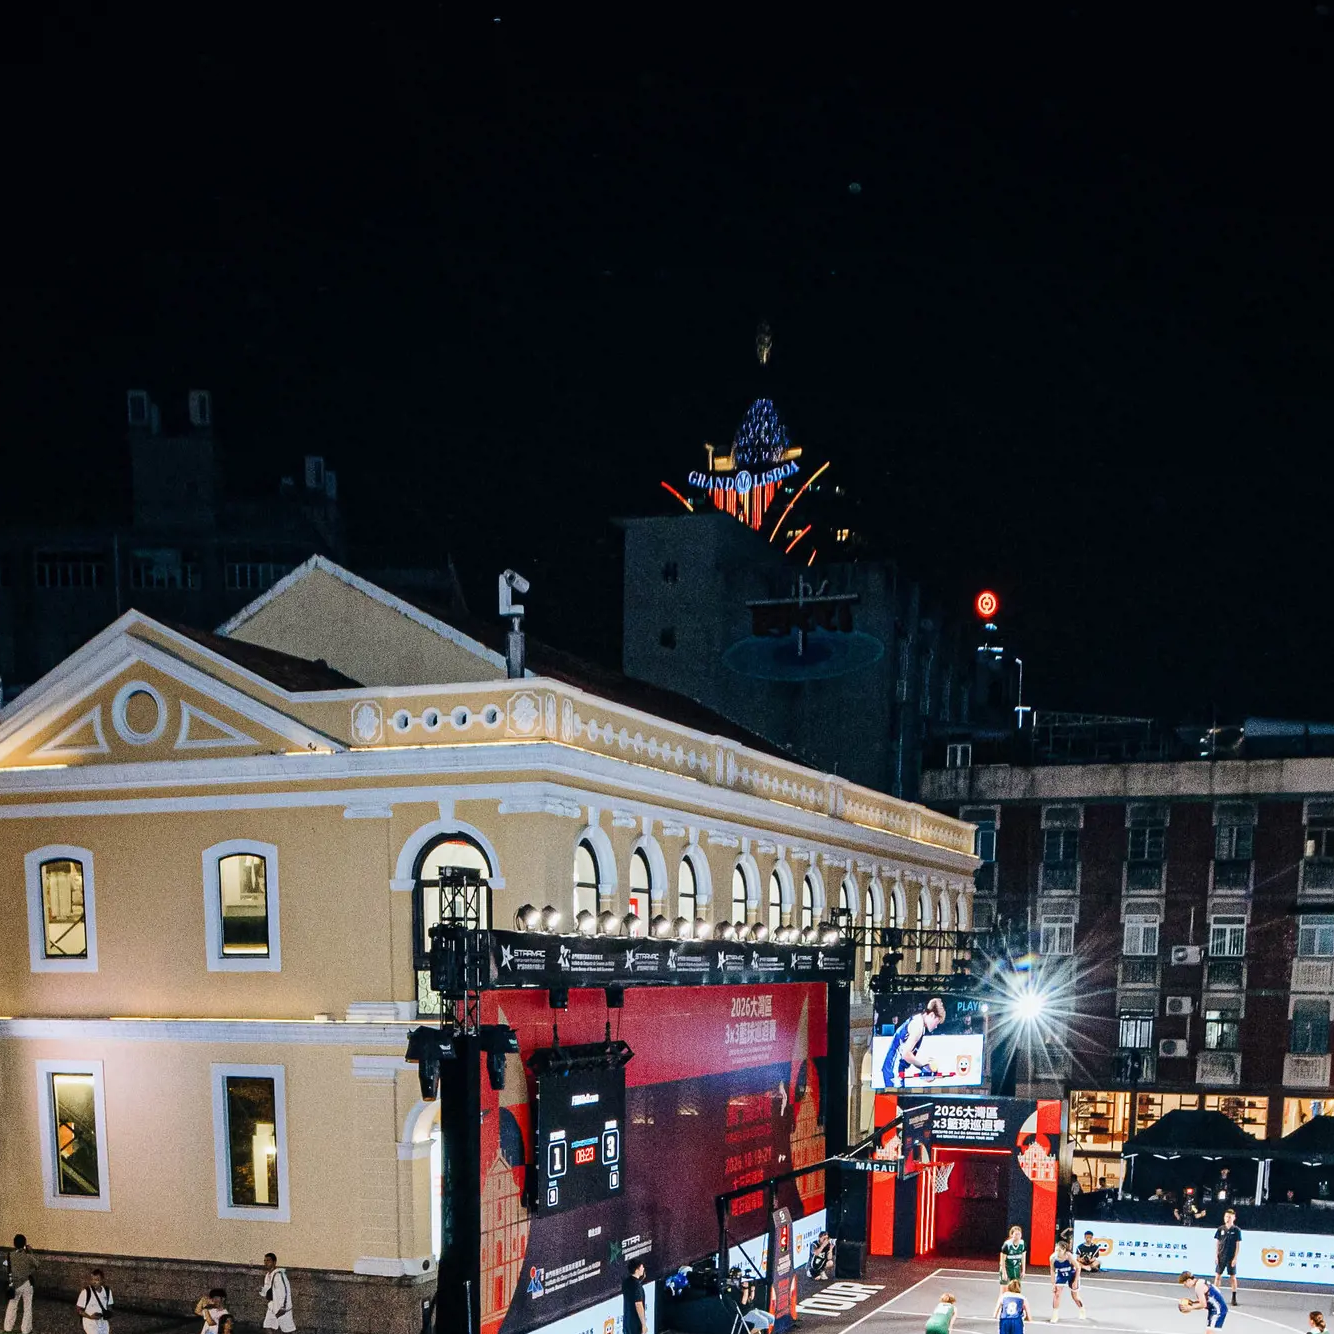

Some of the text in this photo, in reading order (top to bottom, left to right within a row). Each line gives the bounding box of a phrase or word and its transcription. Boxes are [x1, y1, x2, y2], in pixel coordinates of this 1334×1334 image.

[688, 460, 800, 491] GRAND LISBOA
[934, 1105, 999, 1119] 2026大灣區
[932, 1118, 1006, 1132] x3籃球巡迴賽
[606, 1135, 615, 1158] 3
[553, 1147, 562, 1171] 1
[855, 1161, 896, 1173] MACAU
[1006, 1302, 1018, 1316] 8
